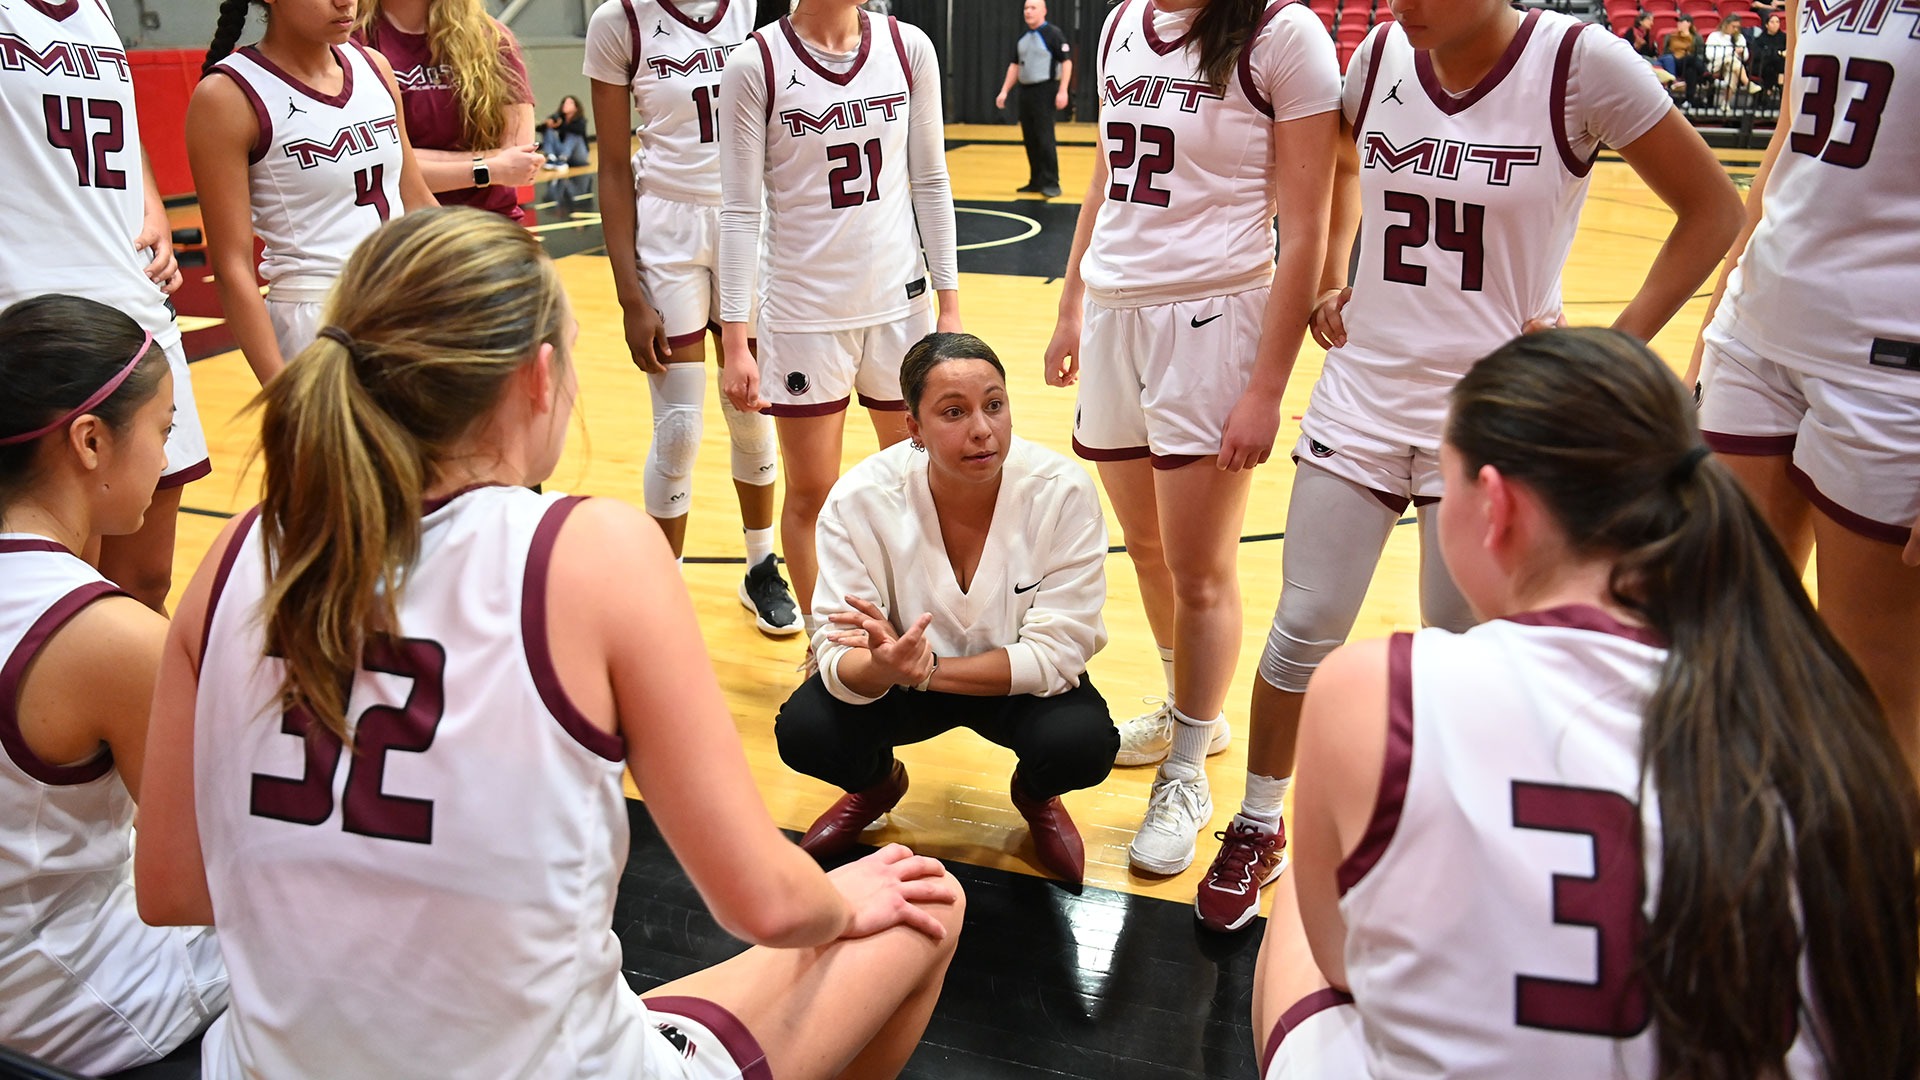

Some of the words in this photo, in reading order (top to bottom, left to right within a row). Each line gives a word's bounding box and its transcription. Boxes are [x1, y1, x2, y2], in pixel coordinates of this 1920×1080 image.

[0, 33, 129, 82] MIT
[647, 43, 744, 79] MI
[692, 84, 720, 143] 1
[779, 91, 907, 137] MIT
[1102, 75, 1227, 113] MIT
[1790, 54, 1895, 169] 33
[42, 93, 127, 190] 42
[283, 114, 399, 170] MIT
[1106, 121, 1175, 208] 22
[1364, 131, 1542, 186] MIT
[354, 163, 390, 226] 4
[826, 138, 882, 209] 21
[1383, 190, 1485, 291] 24
[249, 632, 446, 845] 32
